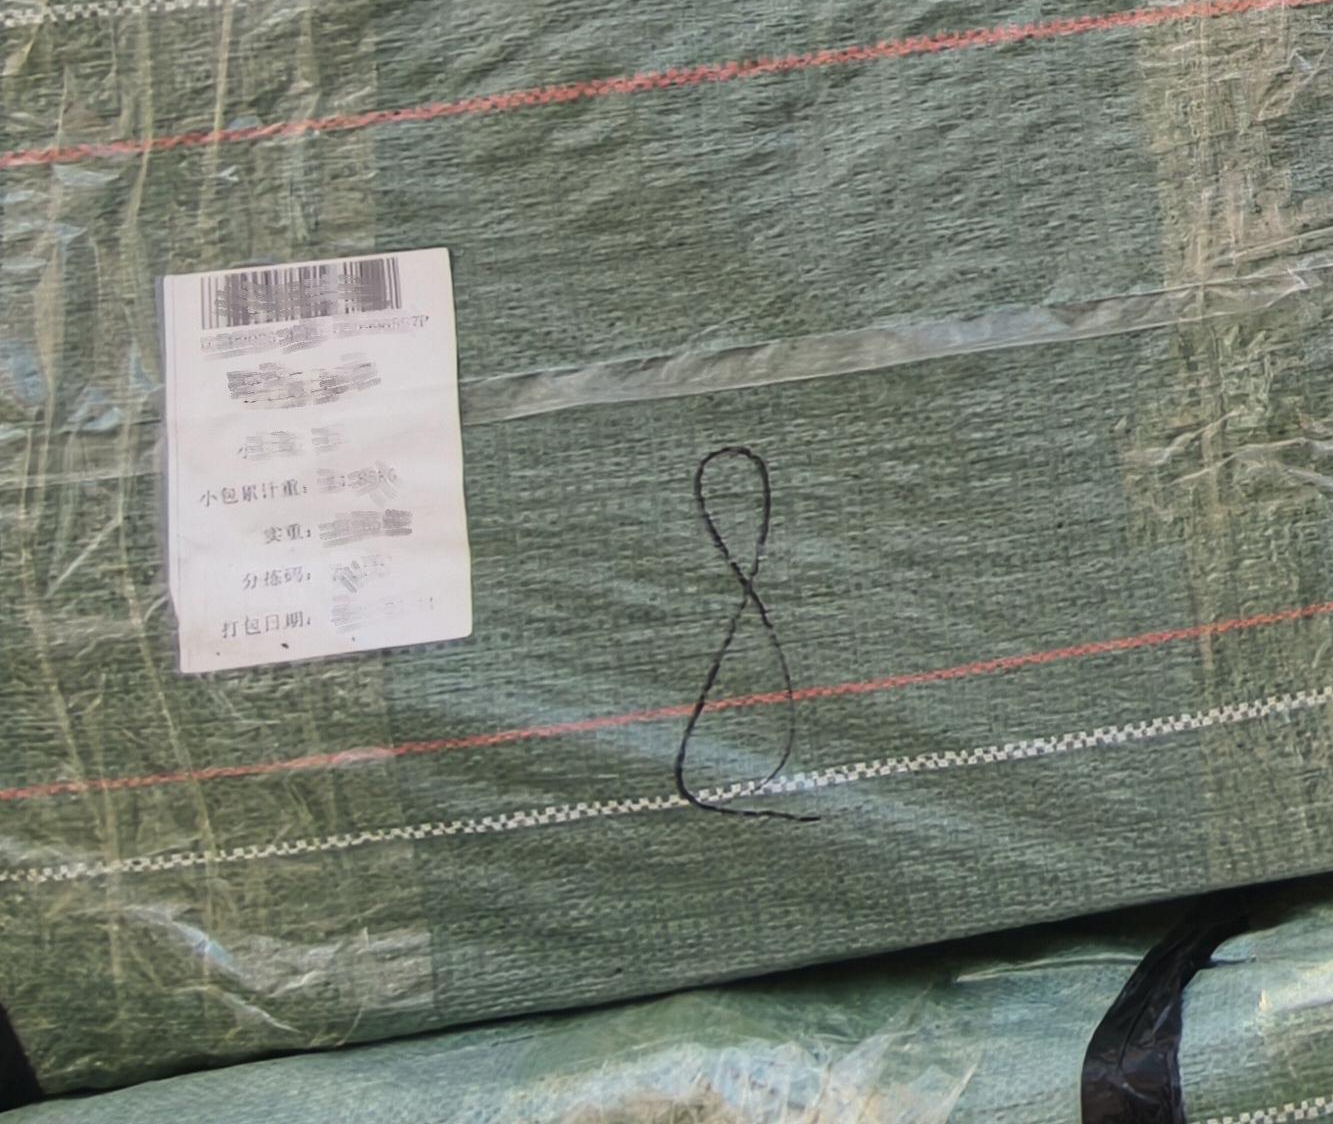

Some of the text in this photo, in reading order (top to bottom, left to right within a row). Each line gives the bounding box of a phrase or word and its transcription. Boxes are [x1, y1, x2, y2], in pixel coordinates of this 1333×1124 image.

[264, 522, 312, 545] 实重：
[222, 610, 311, 639] 打包日期：
